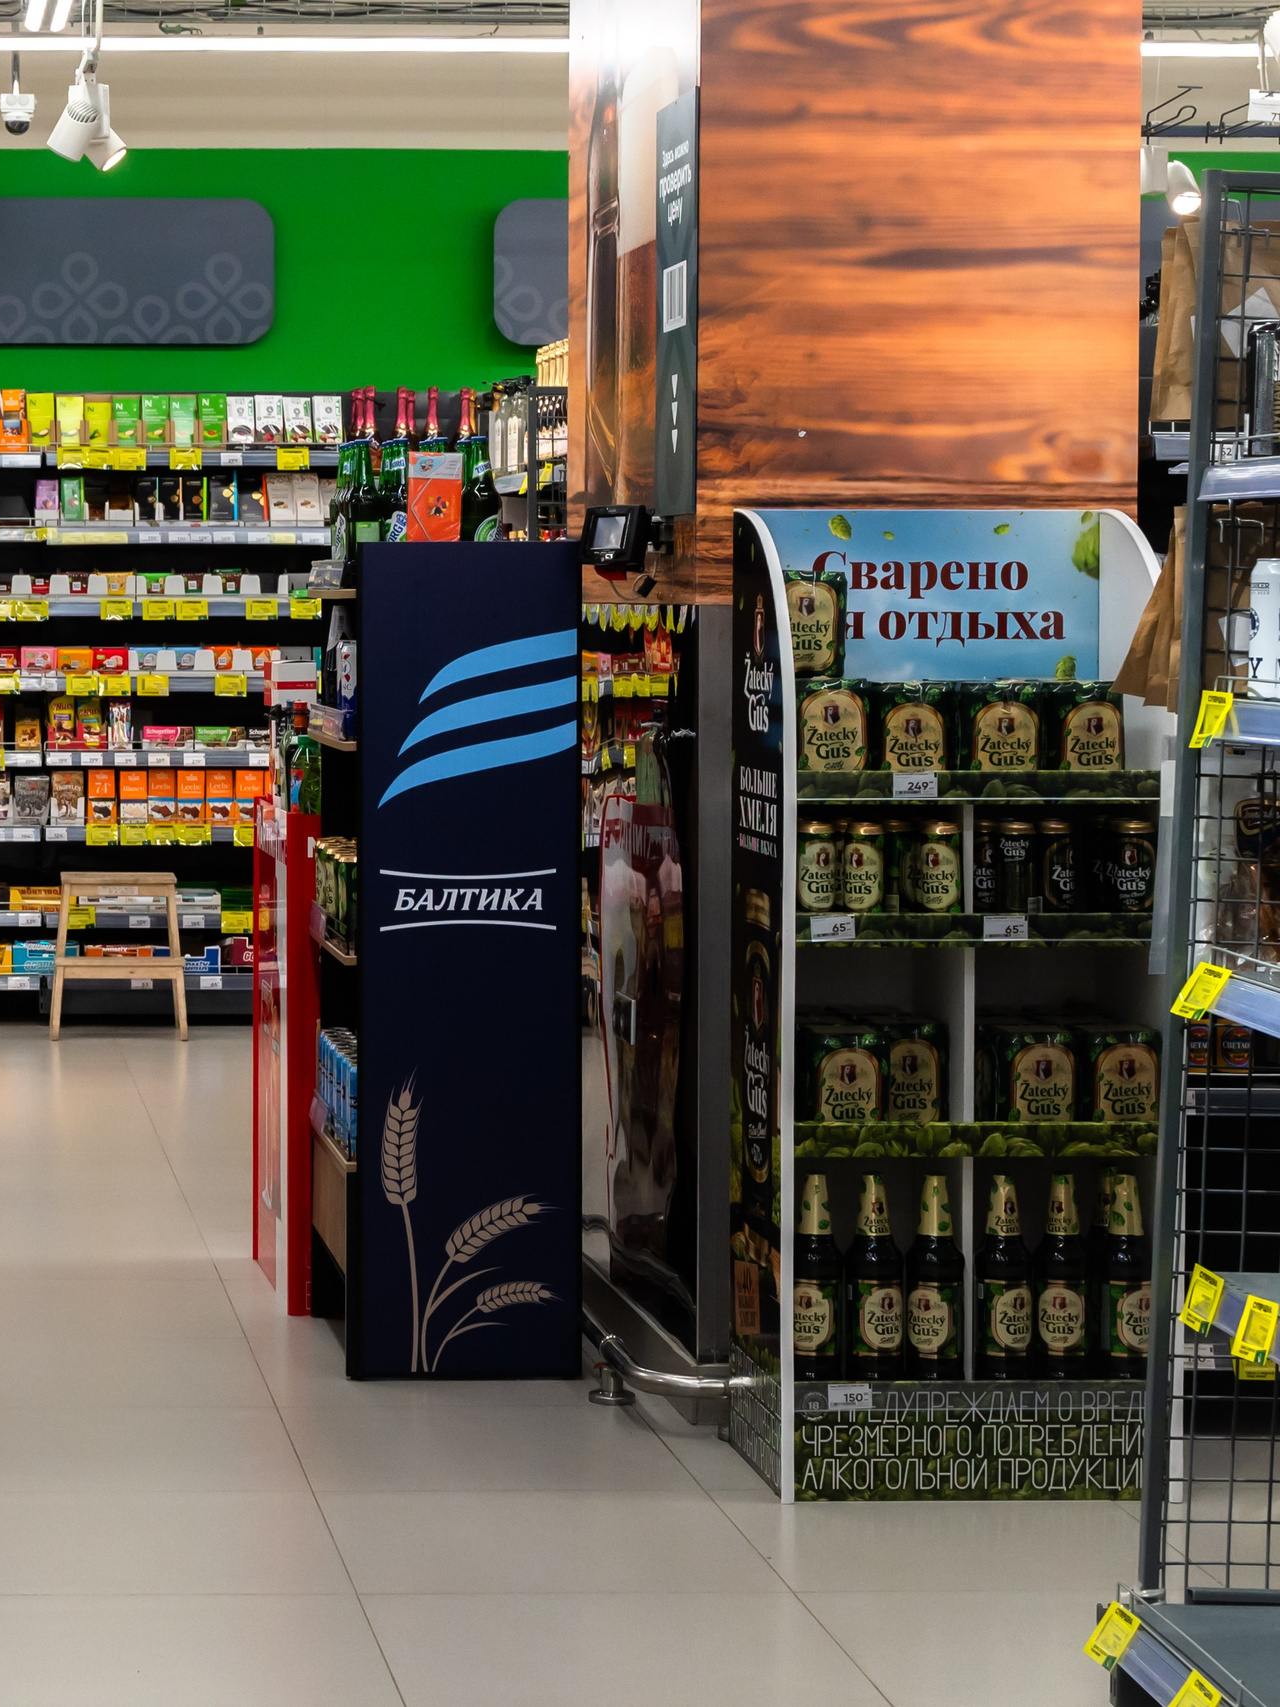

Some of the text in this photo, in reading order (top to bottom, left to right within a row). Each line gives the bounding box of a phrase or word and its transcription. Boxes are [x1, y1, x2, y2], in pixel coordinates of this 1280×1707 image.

[658, 163, 692, 204] проверить
[667, 196, 683, 227] цену
[812, 550, 1029, 600] Сварено
[790, 617, 831, 643] atecký
[878, 608, 1067, 649] отдыха
[743, 652, 775, 701] Žatecký
[748, 694, 770, 732] Gus
[807, 726, 859, 747] Žatecký
[979, 735, 1032, 753] Žatecký
[815, 742, 852, 760] Gus
[889, 737, 941, 754] Žatecký
[896, 751, 934, 767] Gus
[988, 751, 1026, 767] Gus
[1077, 751, 1114, 767] Gus
[739, 765, 778, 799] БОЛЬШЕ
[907, 781, 929, 792] 249
[738, 796, 778, 837] ХМЕЛЯ
[800, 866, 834, 882] Žatec
[844, 870, 879, 883] atecký
[921, 870, 956, 883] atecký
[1116, 866, 1152, 879] atecký
[807, 881, 835, 894] Gus
[844, 881, 873, 895] Gus
[922, 881, 950, 895] Gus
[1116, 878, 1147, 891] Gus
[393, 888, 544, 911] БАЛТИКА
[832, 922, 846, 934] 65
[1004, 924, 1020, 935] 65
[824, 1084, 873, 1104] Žatecký
[1019, 1081, 1070, 1103] Žatecký
[1103, 1079, 1153, 1100] Žatecký
[892, 1094, 928, 1111] Gus
[1026, 1100, 1062, 1117] Gus
[1110, 1099, 1146, 1116] Gus
[830, 1102, 867, 1121] Gus
[794, 1310, 828, 1327] atecký
[907, 1310, 946, 1327] Žatecký
[1039, 1309, 1080, 1326] Žatecký
[793, 1321, 821, 1336] Gus
[873, 1322, 900, 1336] Gus
[911, 1322, 940, 1337] Gus
[1005, 1321, 1031, 1335] Gus
[1045, 1321, 1075, 1335] Gus
[843, 1392, 863, 1403] 150
[1057, 1390, 1074, 1423] О
[1081, 1390, 1147, 1424] ВРЕД
[801, 1425, 972, 1457] ЧРЕЗМЕРНОГО
[802, 1452, 1143, 1492] АЛКОГОЛЬНОЙ ПРОДУКЦИ
